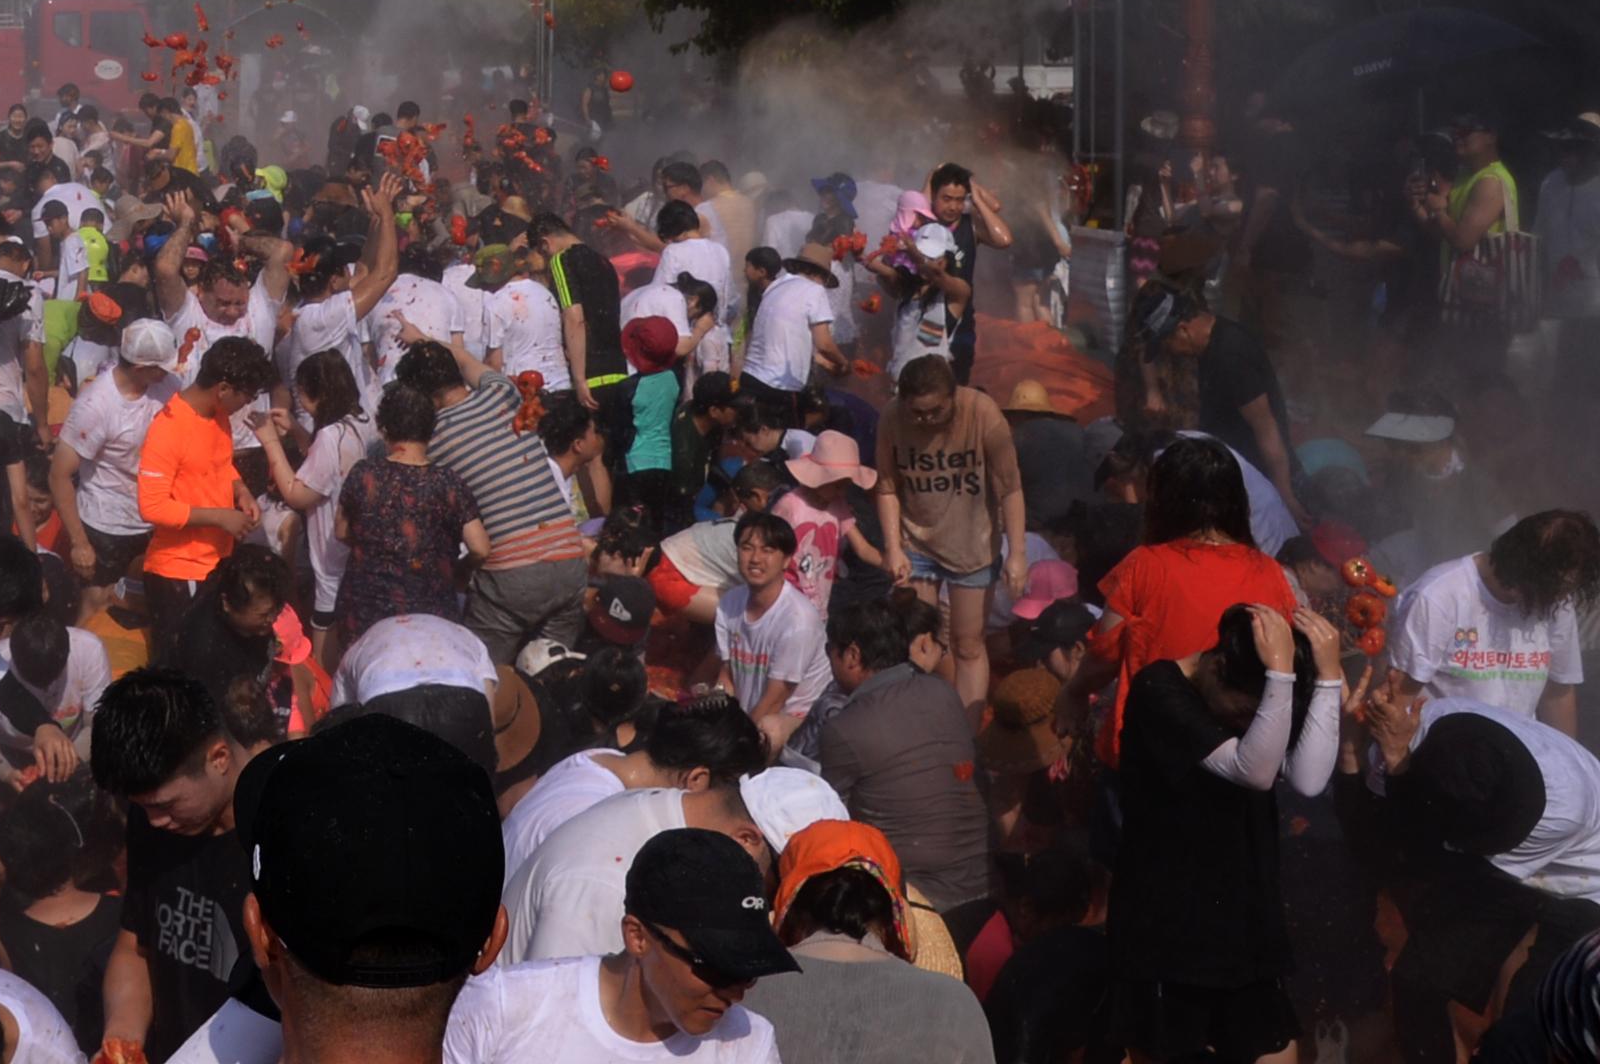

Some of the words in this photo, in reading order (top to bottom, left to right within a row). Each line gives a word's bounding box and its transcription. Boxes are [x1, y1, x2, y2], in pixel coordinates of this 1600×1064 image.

[1352, 57, 1393, 76] BMW
[176, 886, 214, 922] THE
[741, 896, 765, 911] OR
[158, 928, 211, 970] FACE
